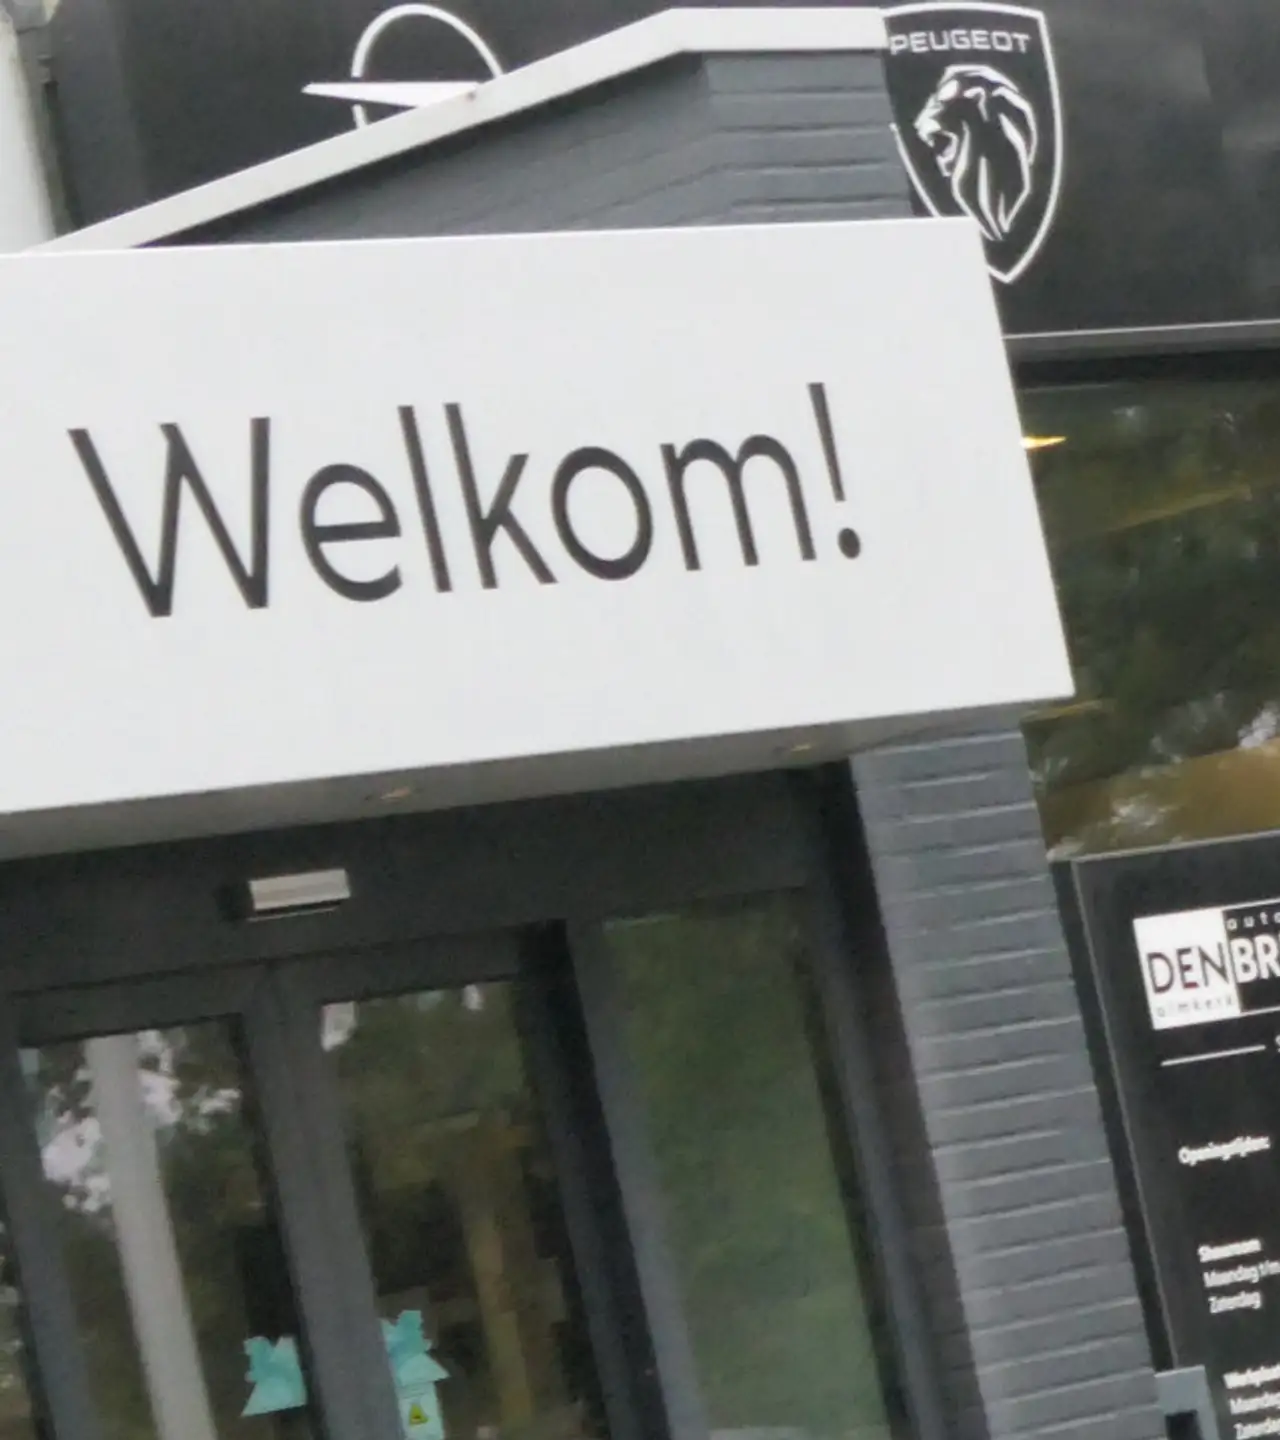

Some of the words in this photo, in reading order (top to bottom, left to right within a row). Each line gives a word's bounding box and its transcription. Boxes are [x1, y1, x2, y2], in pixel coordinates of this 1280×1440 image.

[889, 29, 1032, 55] PEUGEOT
[67, 382, 862, 618] Welkom!
[1146, 942, 1233, 995] DEN
